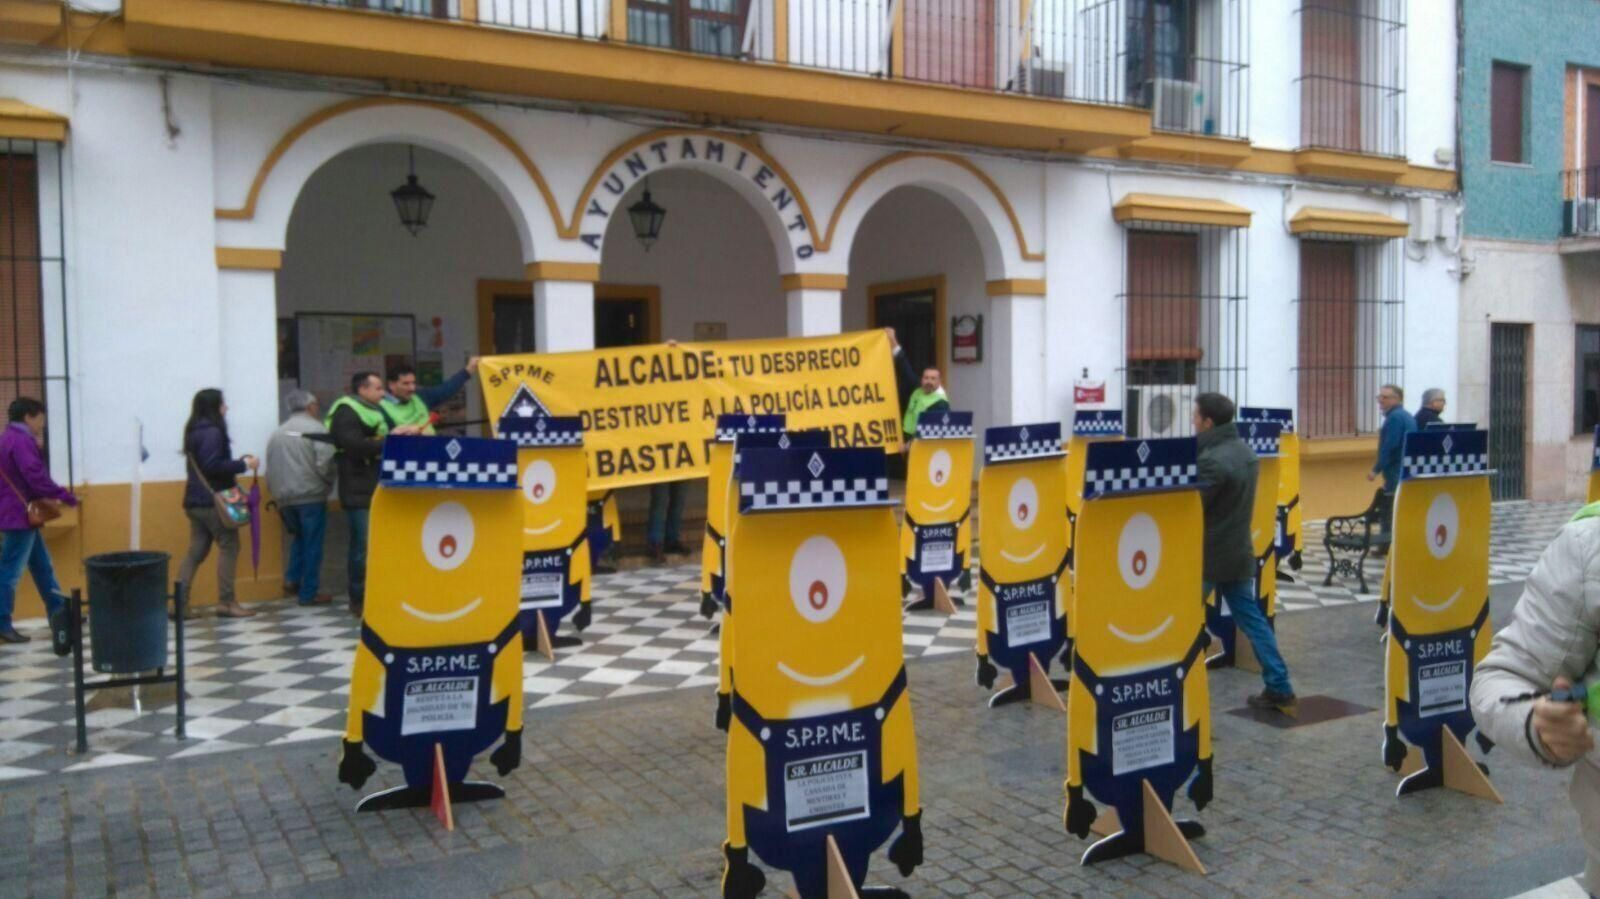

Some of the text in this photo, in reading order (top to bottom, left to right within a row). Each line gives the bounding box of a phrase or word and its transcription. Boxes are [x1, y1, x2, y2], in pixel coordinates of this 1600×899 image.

[580, 138, 814, 260] AYUNTAMIENTO
[489, 364, 555, 388] SPPME
[595, 346, 860, 388] ALCALDE: TU DESPRECIO
[578, 382, 885, 431] DESTRUYE A LA POLICÍA LOCAL
[596, 441, 695, 477] BASTA
[785, 722, 865, 748] S.P.P.M.E.
[810, 756, 859, 775] ALCALDE
